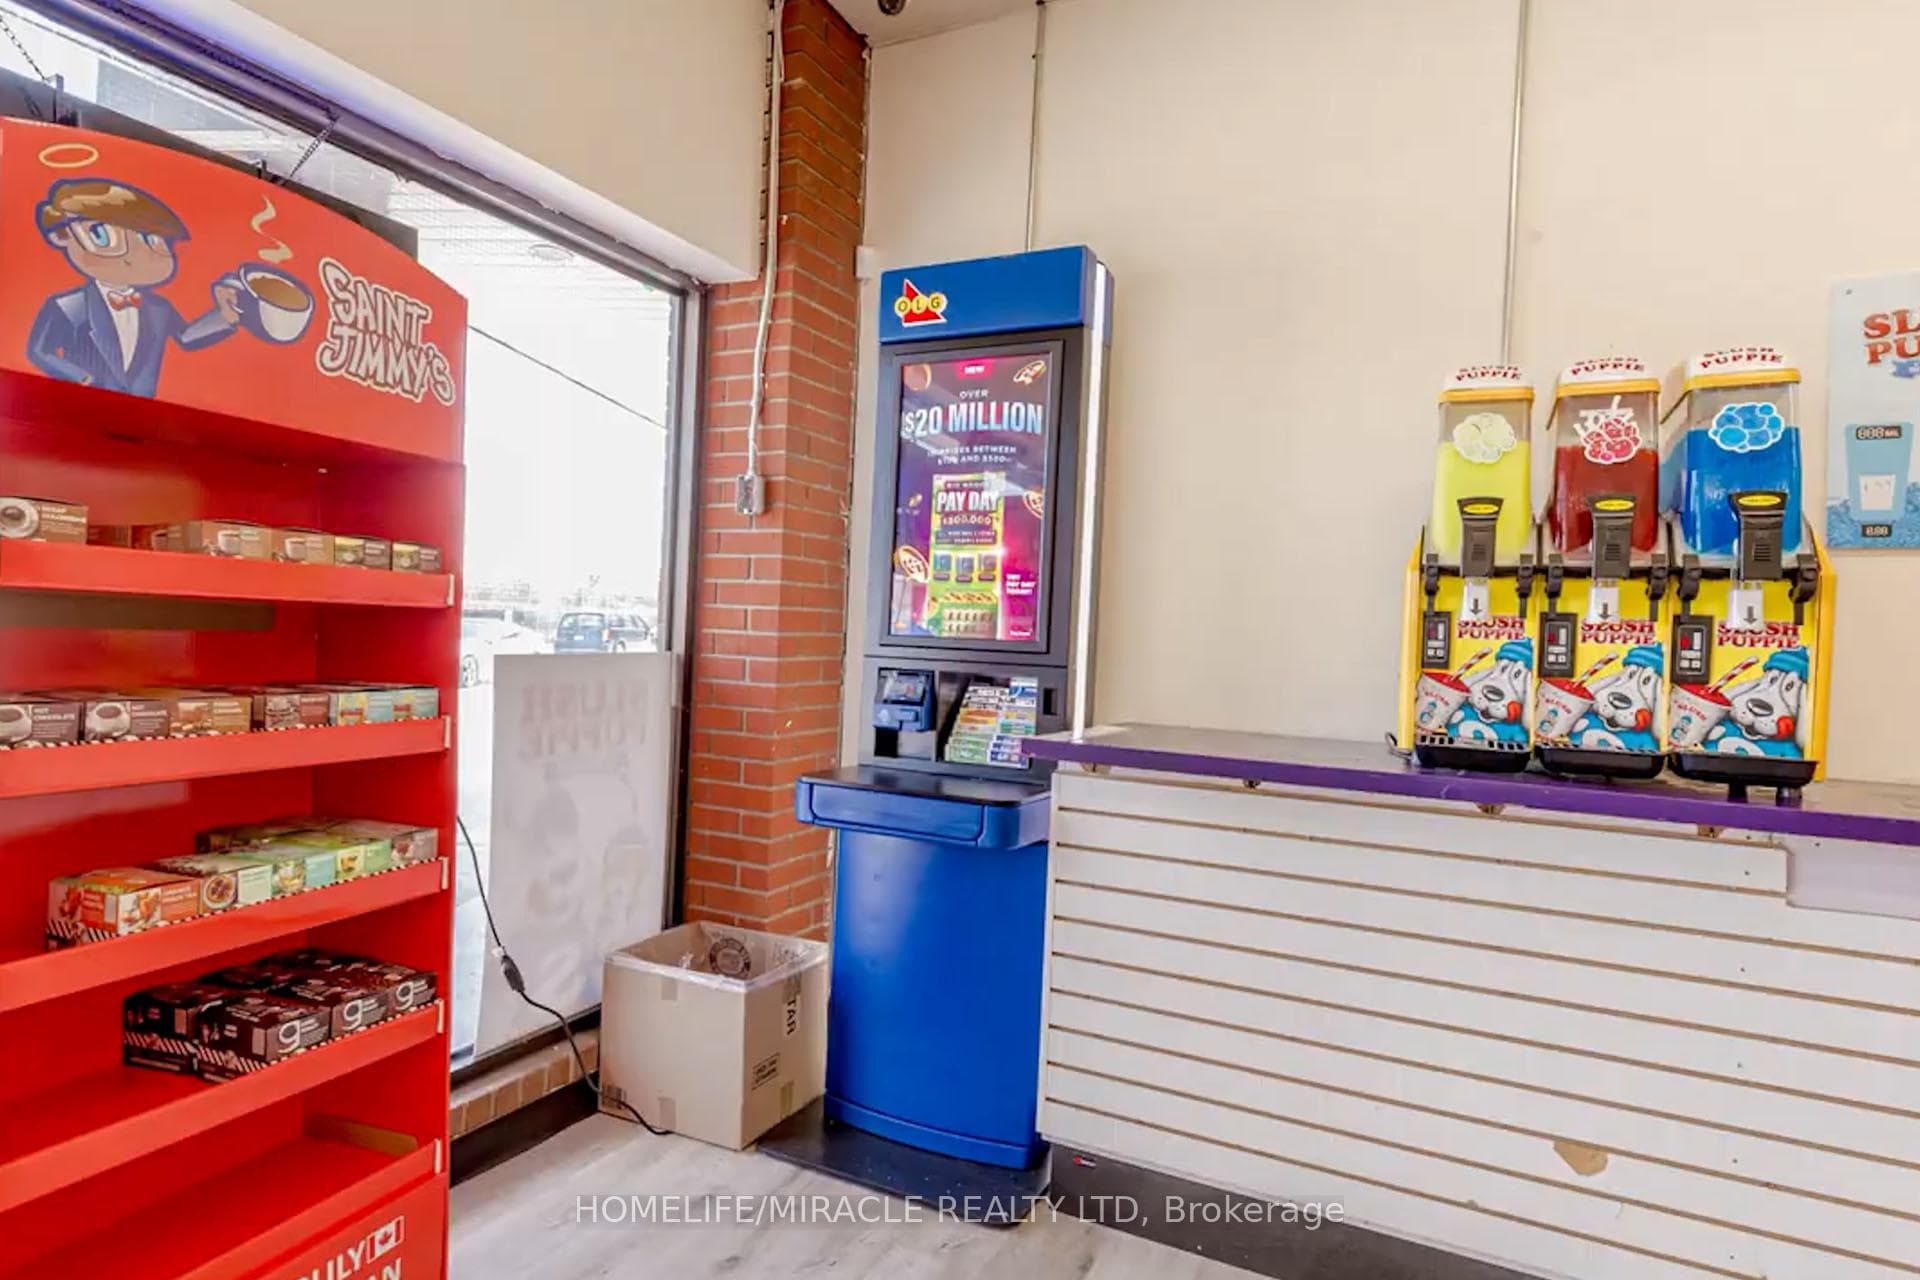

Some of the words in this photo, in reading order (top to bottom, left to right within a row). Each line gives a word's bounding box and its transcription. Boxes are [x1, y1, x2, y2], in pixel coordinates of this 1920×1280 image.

[319, 257, 433, 350] SAINT
[896, 294, 944, 314] OLG
[316, 323, 455, 404] JIMMY'S
[959, 390, 989, 399] OVER
[904, 405, 943, 437] $20
[948, 402, 1042, 434] MILLION
[973, 445, 1016, 454] BETWEEN
[937, 491, 966, 512] PAY
[969, 491, 999, 511] DAY
[1718, 635, 1799, 648] PUPPIE
